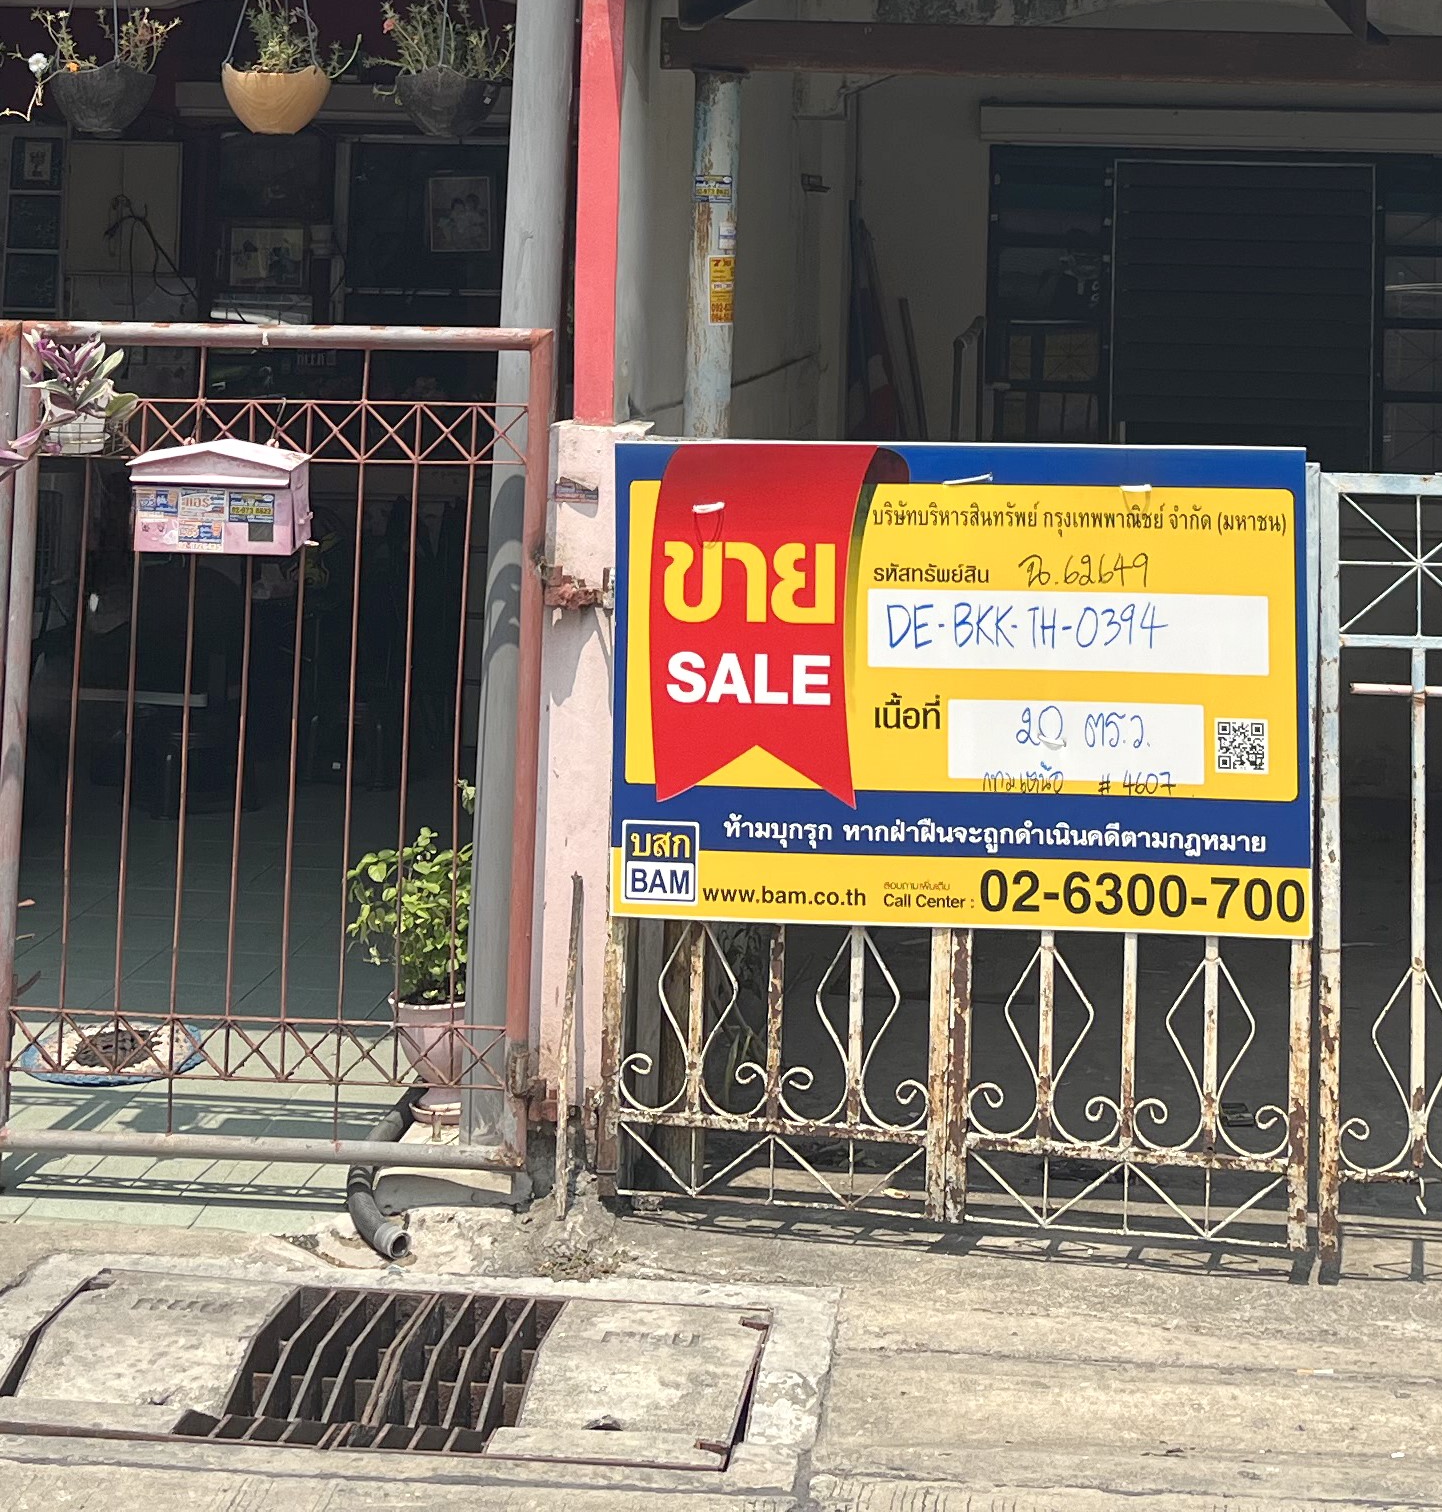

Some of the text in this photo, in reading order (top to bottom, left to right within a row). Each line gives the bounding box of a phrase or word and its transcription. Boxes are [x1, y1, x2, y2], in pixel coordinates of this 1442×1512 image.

[873, 500, 1287, 537] บริษัทบริหารสินทรัพย์ กรุงเทพพาณิชย์ จำกัด (มหาชน)
[664, 540, 836, 624] ขาย
[873, 562, 990, 585] รหัสทรัพย์สิน
[886, 601, 1169, 650] DE-BKK-TH-0394
[666, 651, 832, 706] SALE
[874, 692, 942, 730] เนื้อที่
[630, 831, 691, 859] บสก
[723, 812, 1267, 858] ห้ามบุกรุก หากฝ่าฝืนจะถูกดำเนินคดีตามกฎหมาย
[630, 867, 691, 896] BAM
[702, 885, 867, 907] www.bam.co.th
[979, 868, 1306, 923] 02-6300-700
[883, 893, 911, 908] Call
[915, 894, 966, 909] Center
